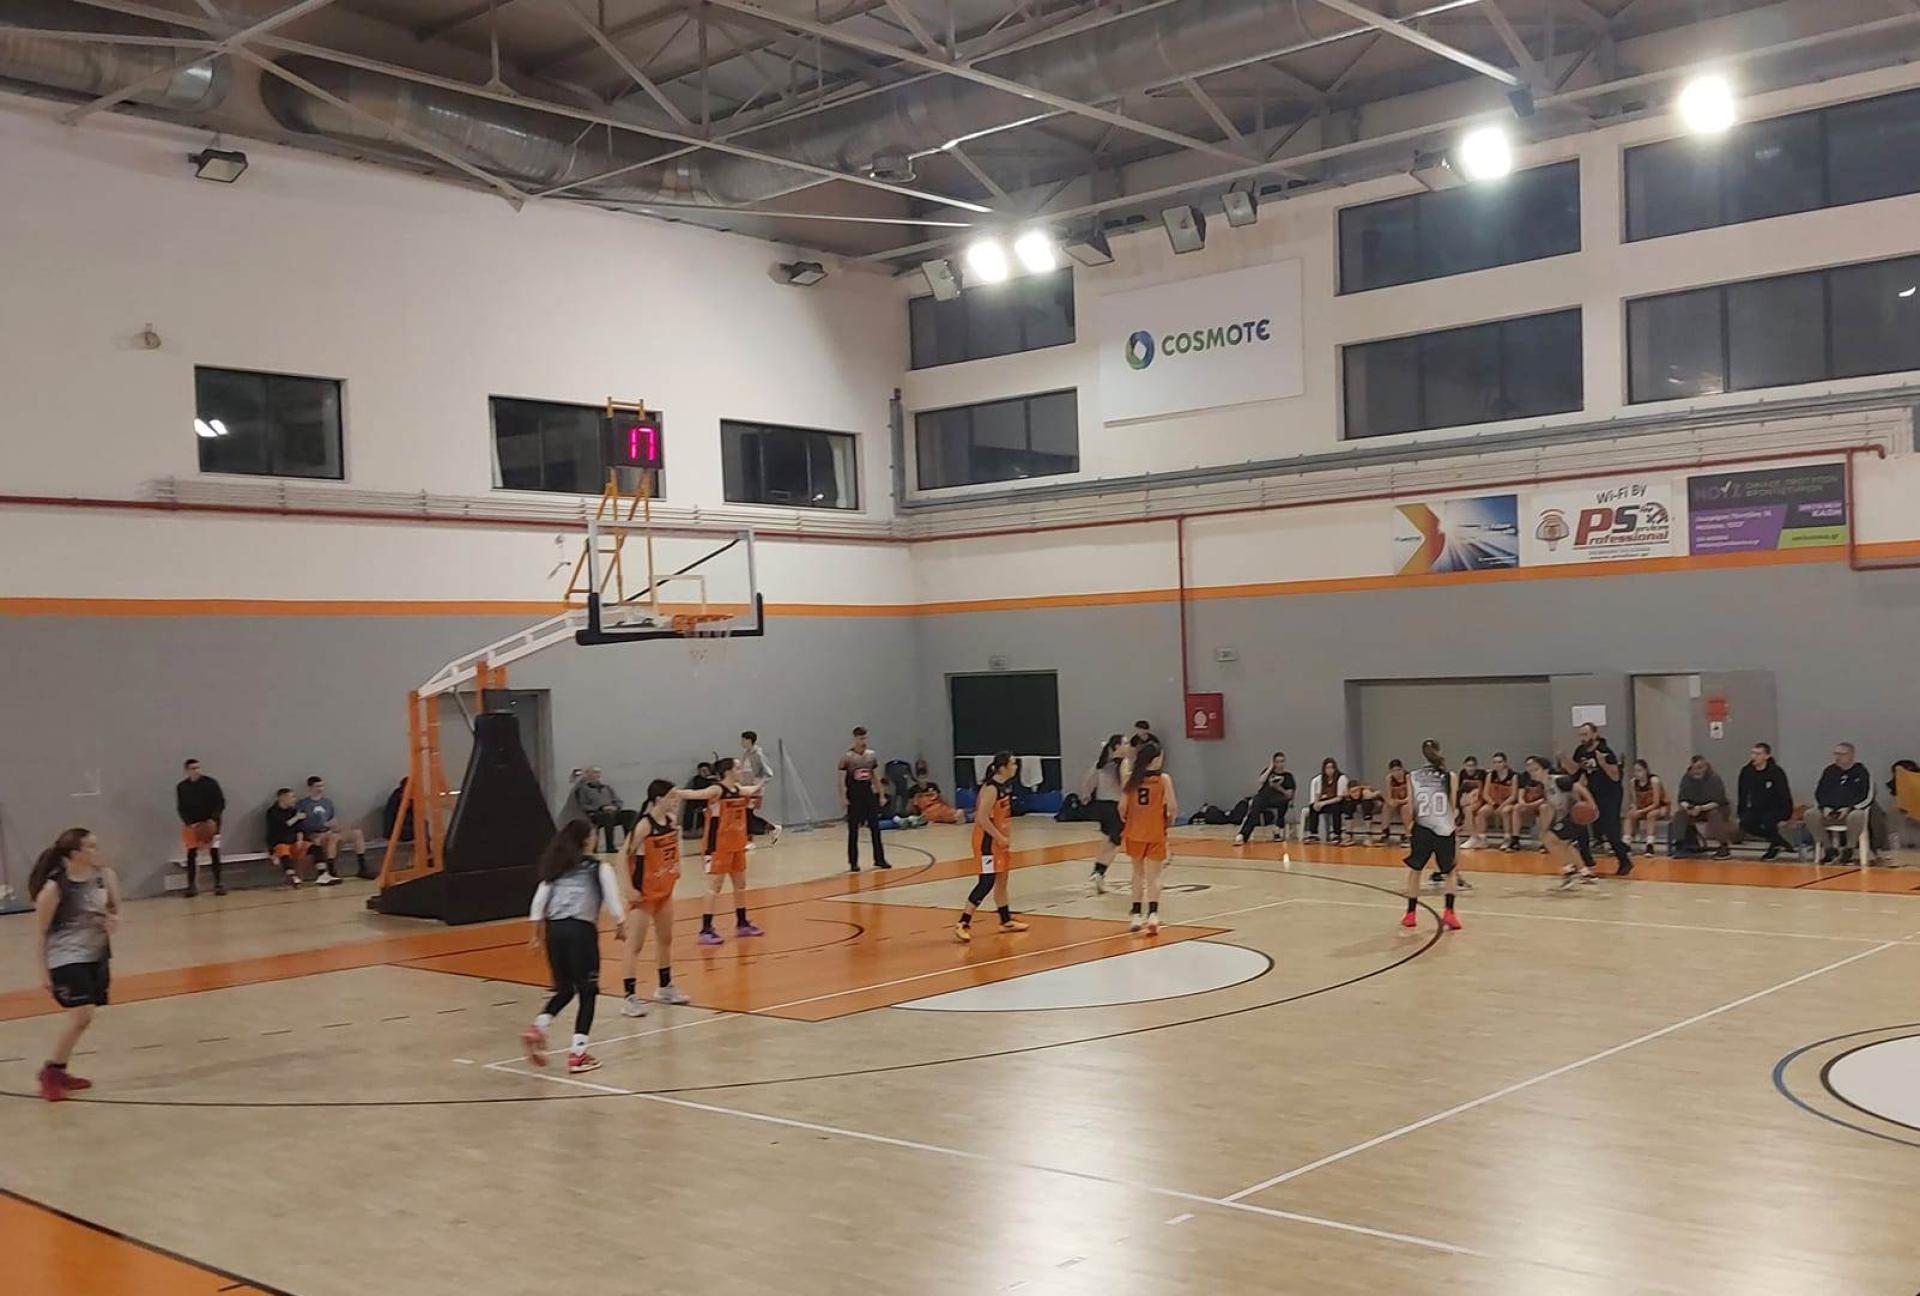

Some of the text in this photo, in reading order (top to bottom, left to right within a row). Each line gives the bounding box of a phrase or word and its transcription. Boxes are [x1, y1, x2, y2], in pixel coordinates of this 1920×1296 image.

[1161, 318, 1271, 356] COSMOTE
[1596, 486, 1629, 504] Wi-Fi
[1138, 787, 1150, 805] 8
[1416, 791, 1448, 817] 20
